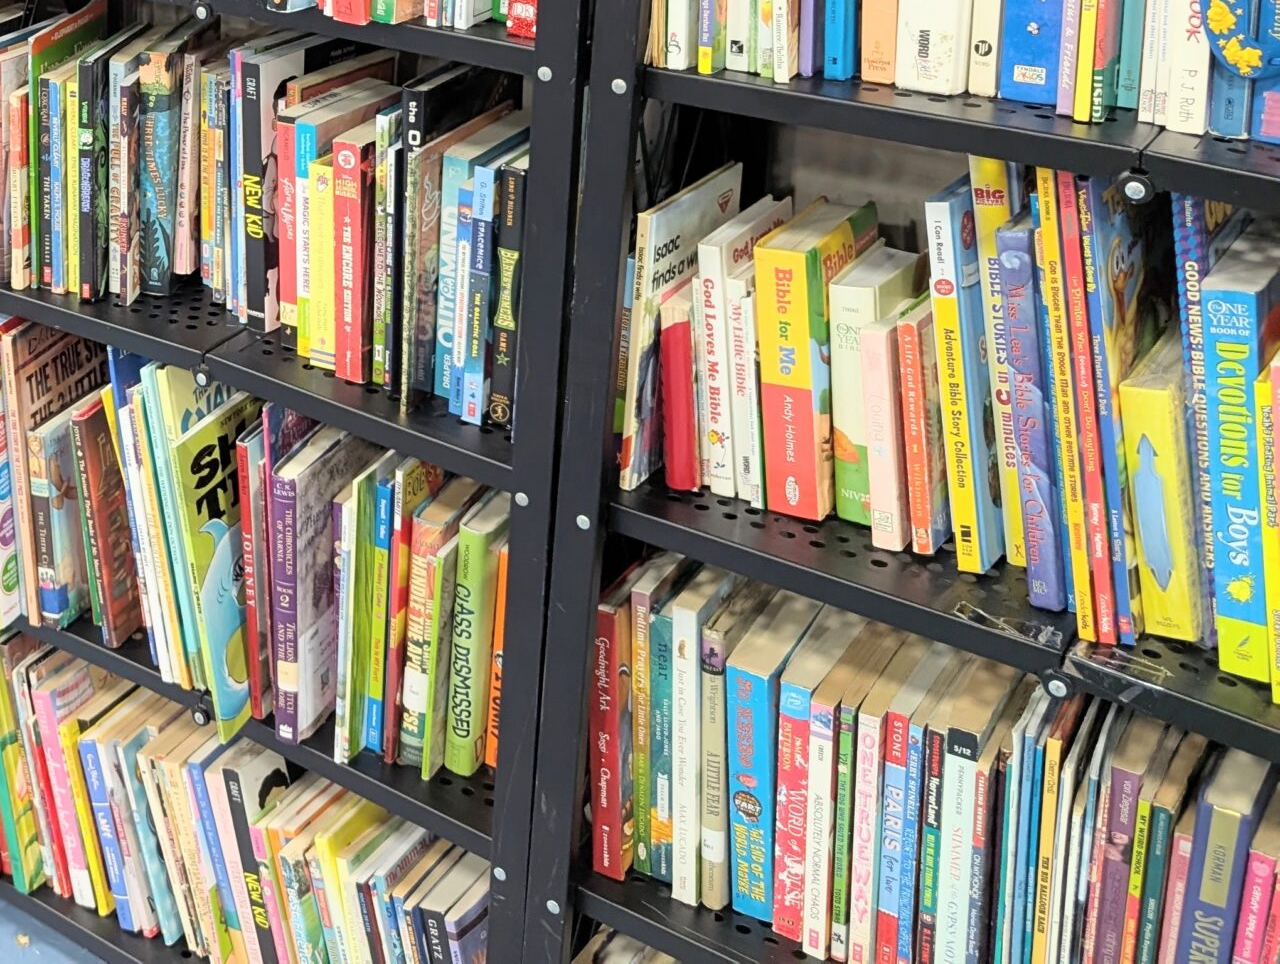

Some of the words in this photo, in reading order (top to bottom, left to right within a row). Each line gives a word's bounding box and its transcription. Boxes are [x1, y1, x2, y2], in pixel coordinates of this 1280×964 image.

[246, 77, 256, 100] CRAFT
[408, 101, 417, 123] the
[81, 158, 90, 212] DRAGONBREATH
[974, 188, 1005, 199] BIG
[302, 196, 310, 227] MAGIC
[302, 229, 310, 266] STARTS
[343, 226, 352, 243] THE
[442, 206, 456, 271] MIND
[652, 235, 680, 263] Isaac
[302, 268, 310, 293] HERE!
[342, 244, 353, 288] ENCORE
[1184, 261, 1197, 303] GOOD
[344, 289, 352, 323] EDITION
[499, 249, 518, 328] BARNSTORMERS
[702, 277, 715, 303] God
[774, 267, 793, 314] Bible
[1207, 298, 1248, 315] ONE
[438, 294, 454, 349] OUT
[703, 305, 717, 355] Loves
[778, 320, 792, 343] for
[1188, 307, 1200, 351] NEWS:
[1206, 314, 1252, 328] YEAR
[499, 332, 507, 352] GAME
[778, 345, 796, 376] Me
[943, 328, 955, 378] Adventure
[25, 373, 54, 405] THE
[53, 354, 85, 393] TRUE
[443, 355, 451, 388] DRAPER
[706, 359, 718, 382] Me
[1191, 352, 1204, 394] BIBLE
[708, 385, 721, 428] Bible
[782, 394, 794, 420] Andy
[949, 382, 958, 405] Bible
[1214, 341, 1250, 468] Devotions
[951, 408, 962, 438] Story
[1193, 395, 1208, 468] QUESTIONS
[783, 424, 795, 463] Holmes
[953, 441, 966, 489] Collection
[272, 489, 295, 497] LEWIS
[1198, 472, 1210, 498] AND
[1220, 473, 1242, 497] for
[277, 519, 283, 528] OF
[285, 508, 293, 521] THE
[285, 524, 293, 575] CHRONICLES
[1201, 501, 1213, 570] ANSWERS
[1216, 501, 1257, 566] Boys
[242, 532, 255, 609] JOURNEY
[464, 544, 472, 580] WOODROW
[279, 594, 290, 609] 2
[459, 584, 473, 636] CLASS
[598, 636, 610, 688] Goodnight
[658, 643, 669, 680] near
[451, 640, 470, 739] DISMISSED
[599, 690, 609, 711] Ark
[782, 722, 790, 772] PATTERSON
[893, 721, 902, 758] STONE
[954, 745, 972, 756] 5/12
[229, 781, 240, 803] CRAFT
[1211, 844, 1225, 882] KORMAN
[428, 918, 443, 960] GRATZ
